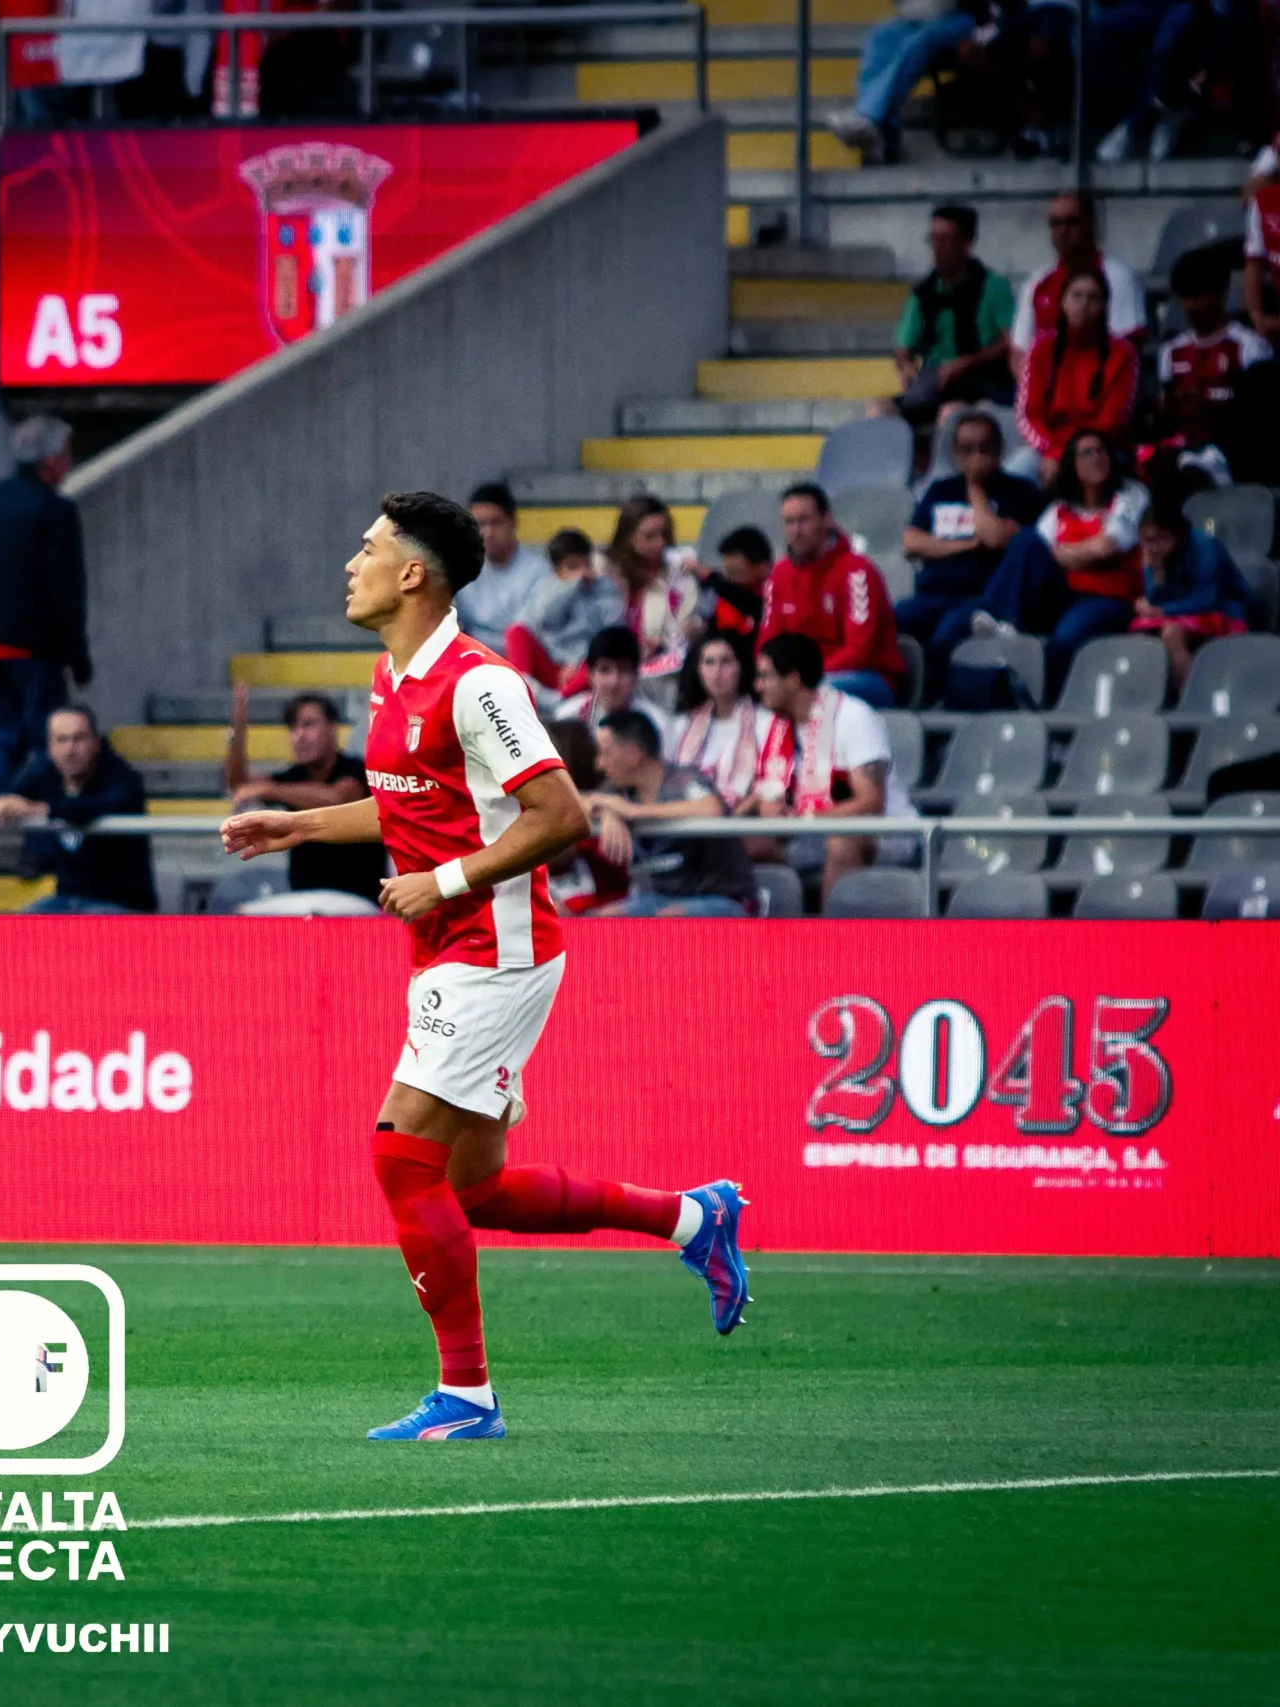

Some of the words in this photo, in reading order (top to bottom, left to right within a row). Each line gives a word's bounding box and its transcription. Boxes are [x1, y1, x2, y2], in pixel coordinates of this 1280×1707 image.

[28, 294, 122, 368] A5
[478, 690, 522, 760] tek4life
[807, 994, 1174, 1137] 2045
[803, 1142, 920, 1168] EMPRESA
[924, 1143, 958, 1168] DE
